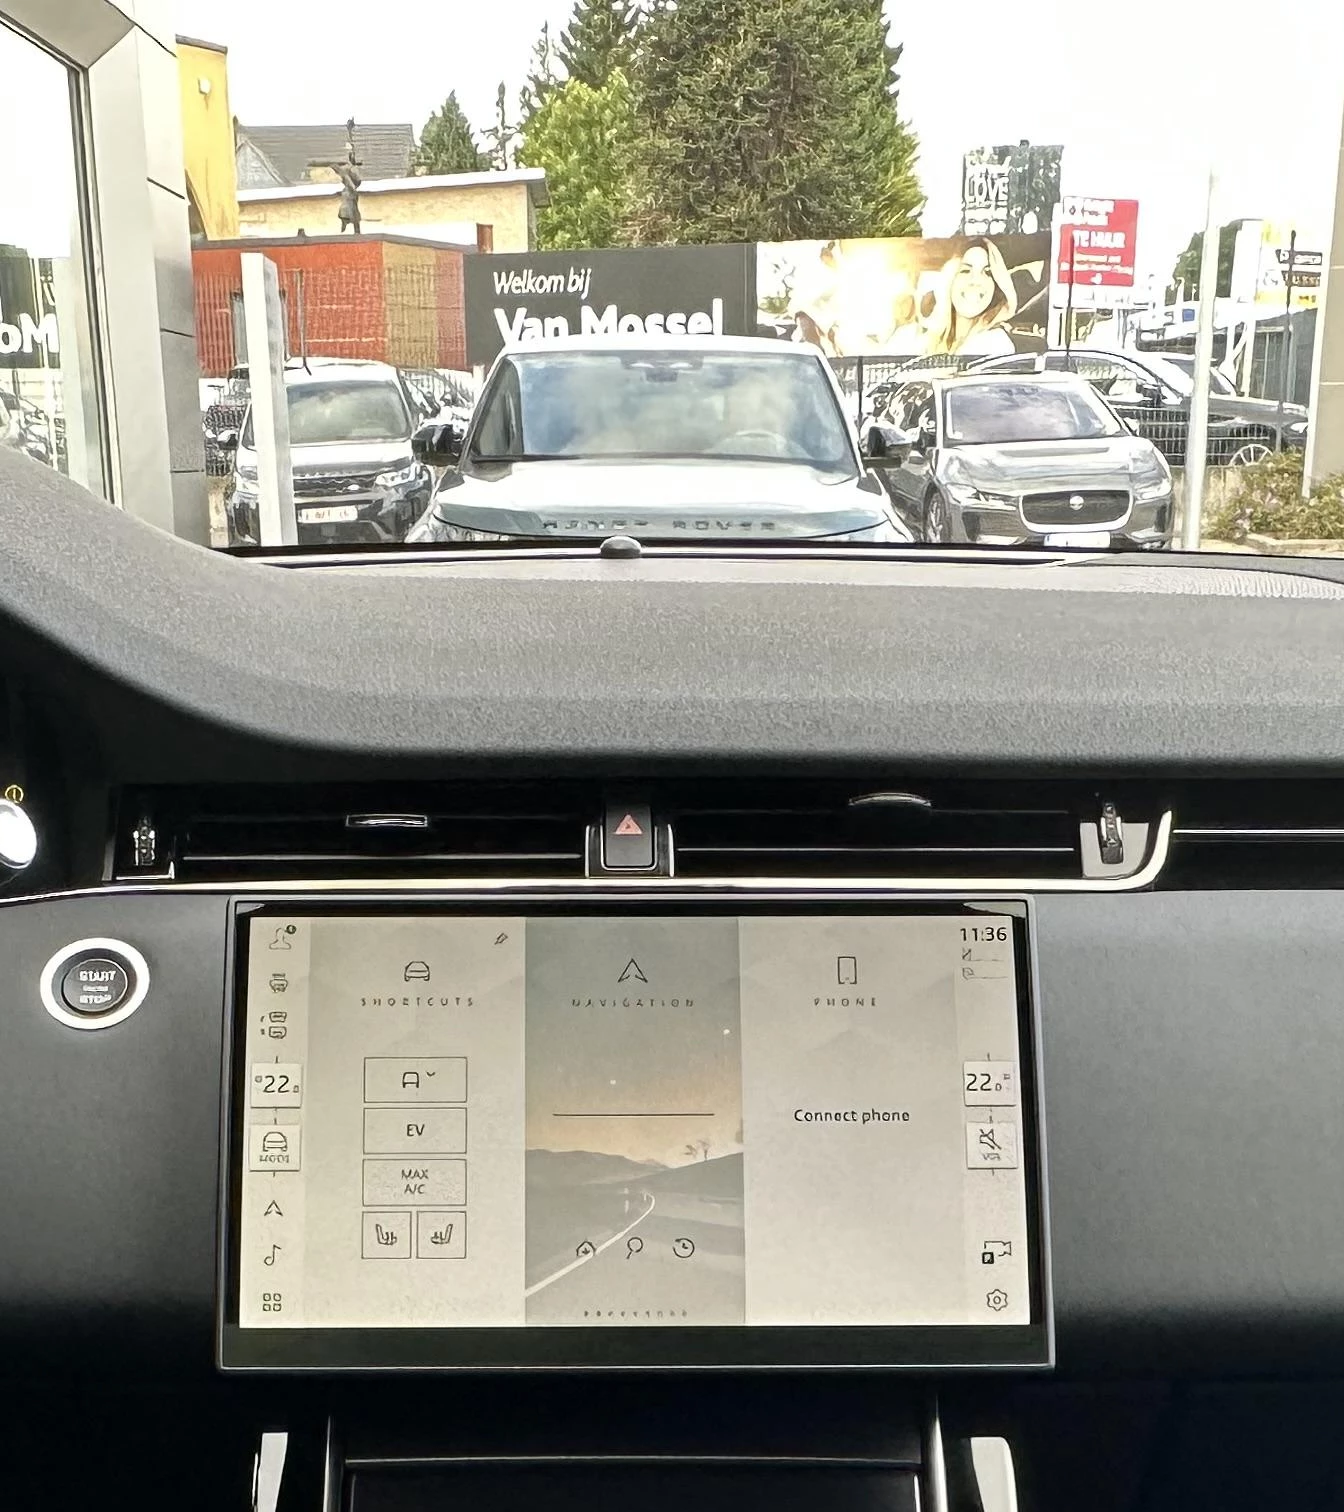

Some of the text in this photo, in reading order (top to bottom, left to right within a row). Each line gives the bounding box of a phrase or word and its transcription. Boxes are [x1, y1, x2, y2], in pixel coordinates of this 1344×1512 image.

[493, 266, 593, 300] Welkom bij
[493, 297, 724, 340] Van Mossel
[959, 926, 1008, 942] 11:36
[360, 997, 474, 1007] SHORTCUTS
[793, 1107, 910, 1125] Connect phone
[406, 1123, 425, 1137] EV
